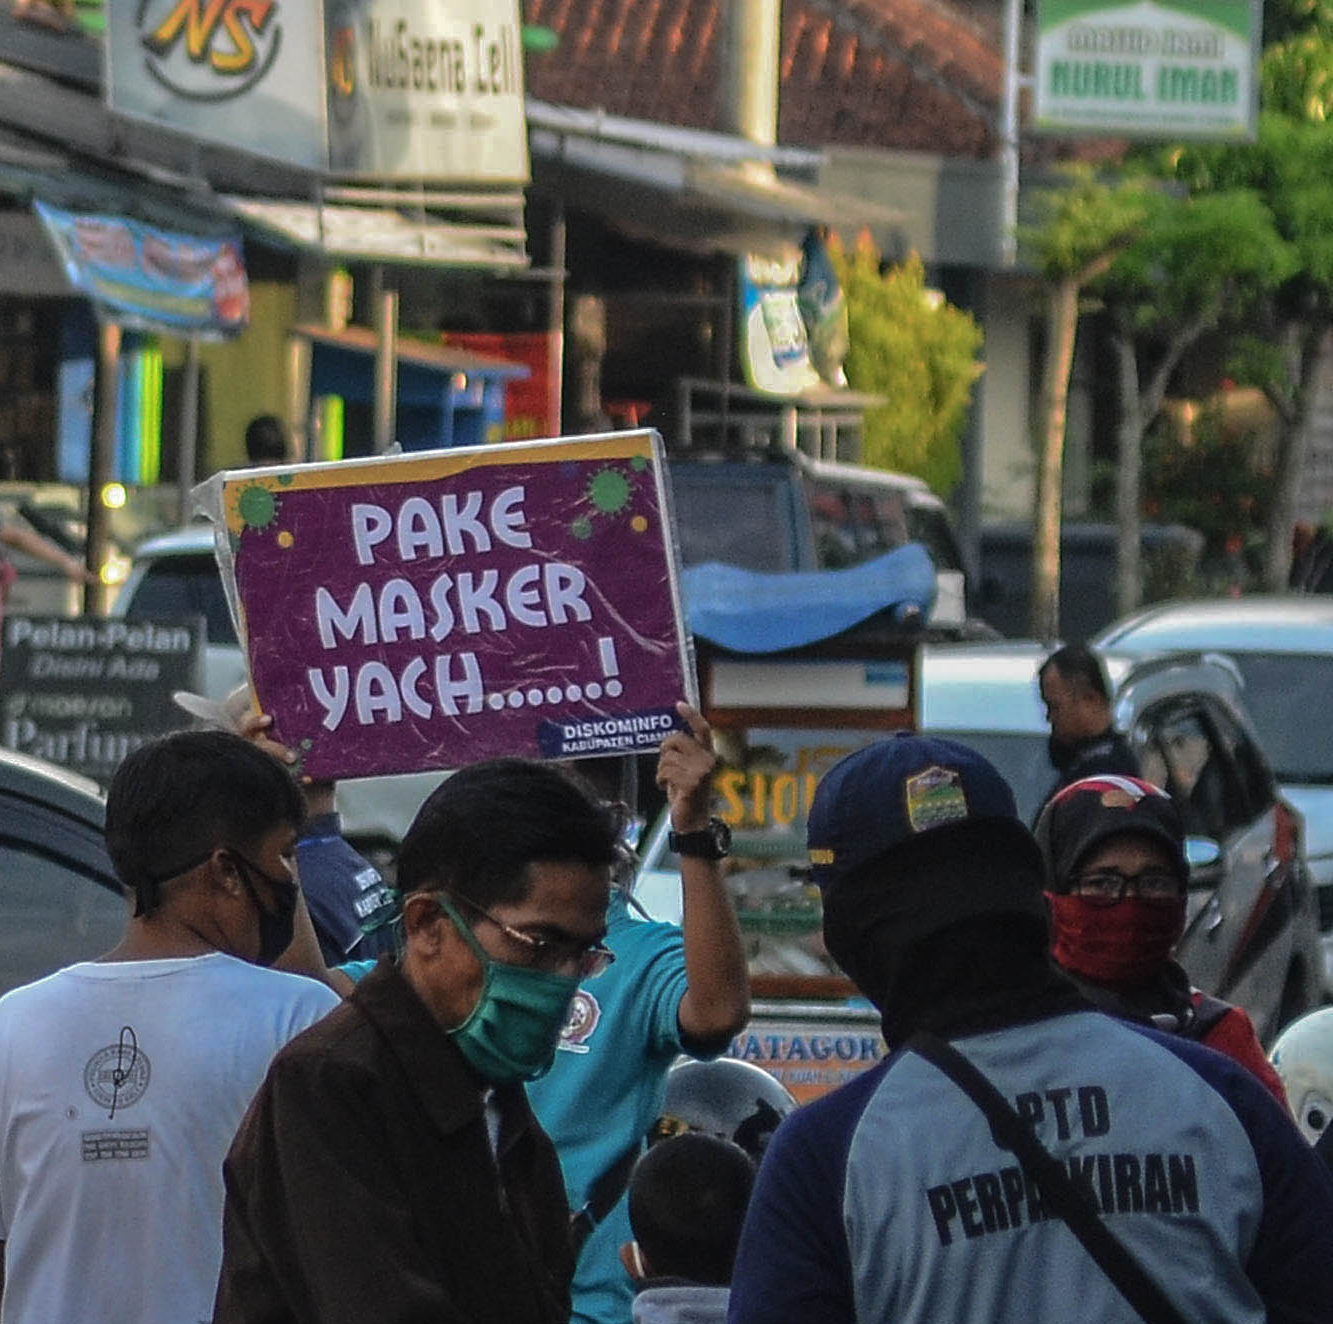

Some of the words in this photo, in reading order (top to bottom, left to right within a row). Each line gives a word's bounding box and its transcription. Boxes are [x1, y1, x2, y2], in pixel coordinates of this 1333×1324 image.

[351, 485, 533, 566] PAKE
[315, 562, 593, 650] MASKER
[561, 737, 634, 753] KABUPATEN
[563, 714, 673, 740] DISKOMINFO
[729, 1034, 879, 1061] ATAGOR
[1016, 1085, 1111, 1141] PTD
